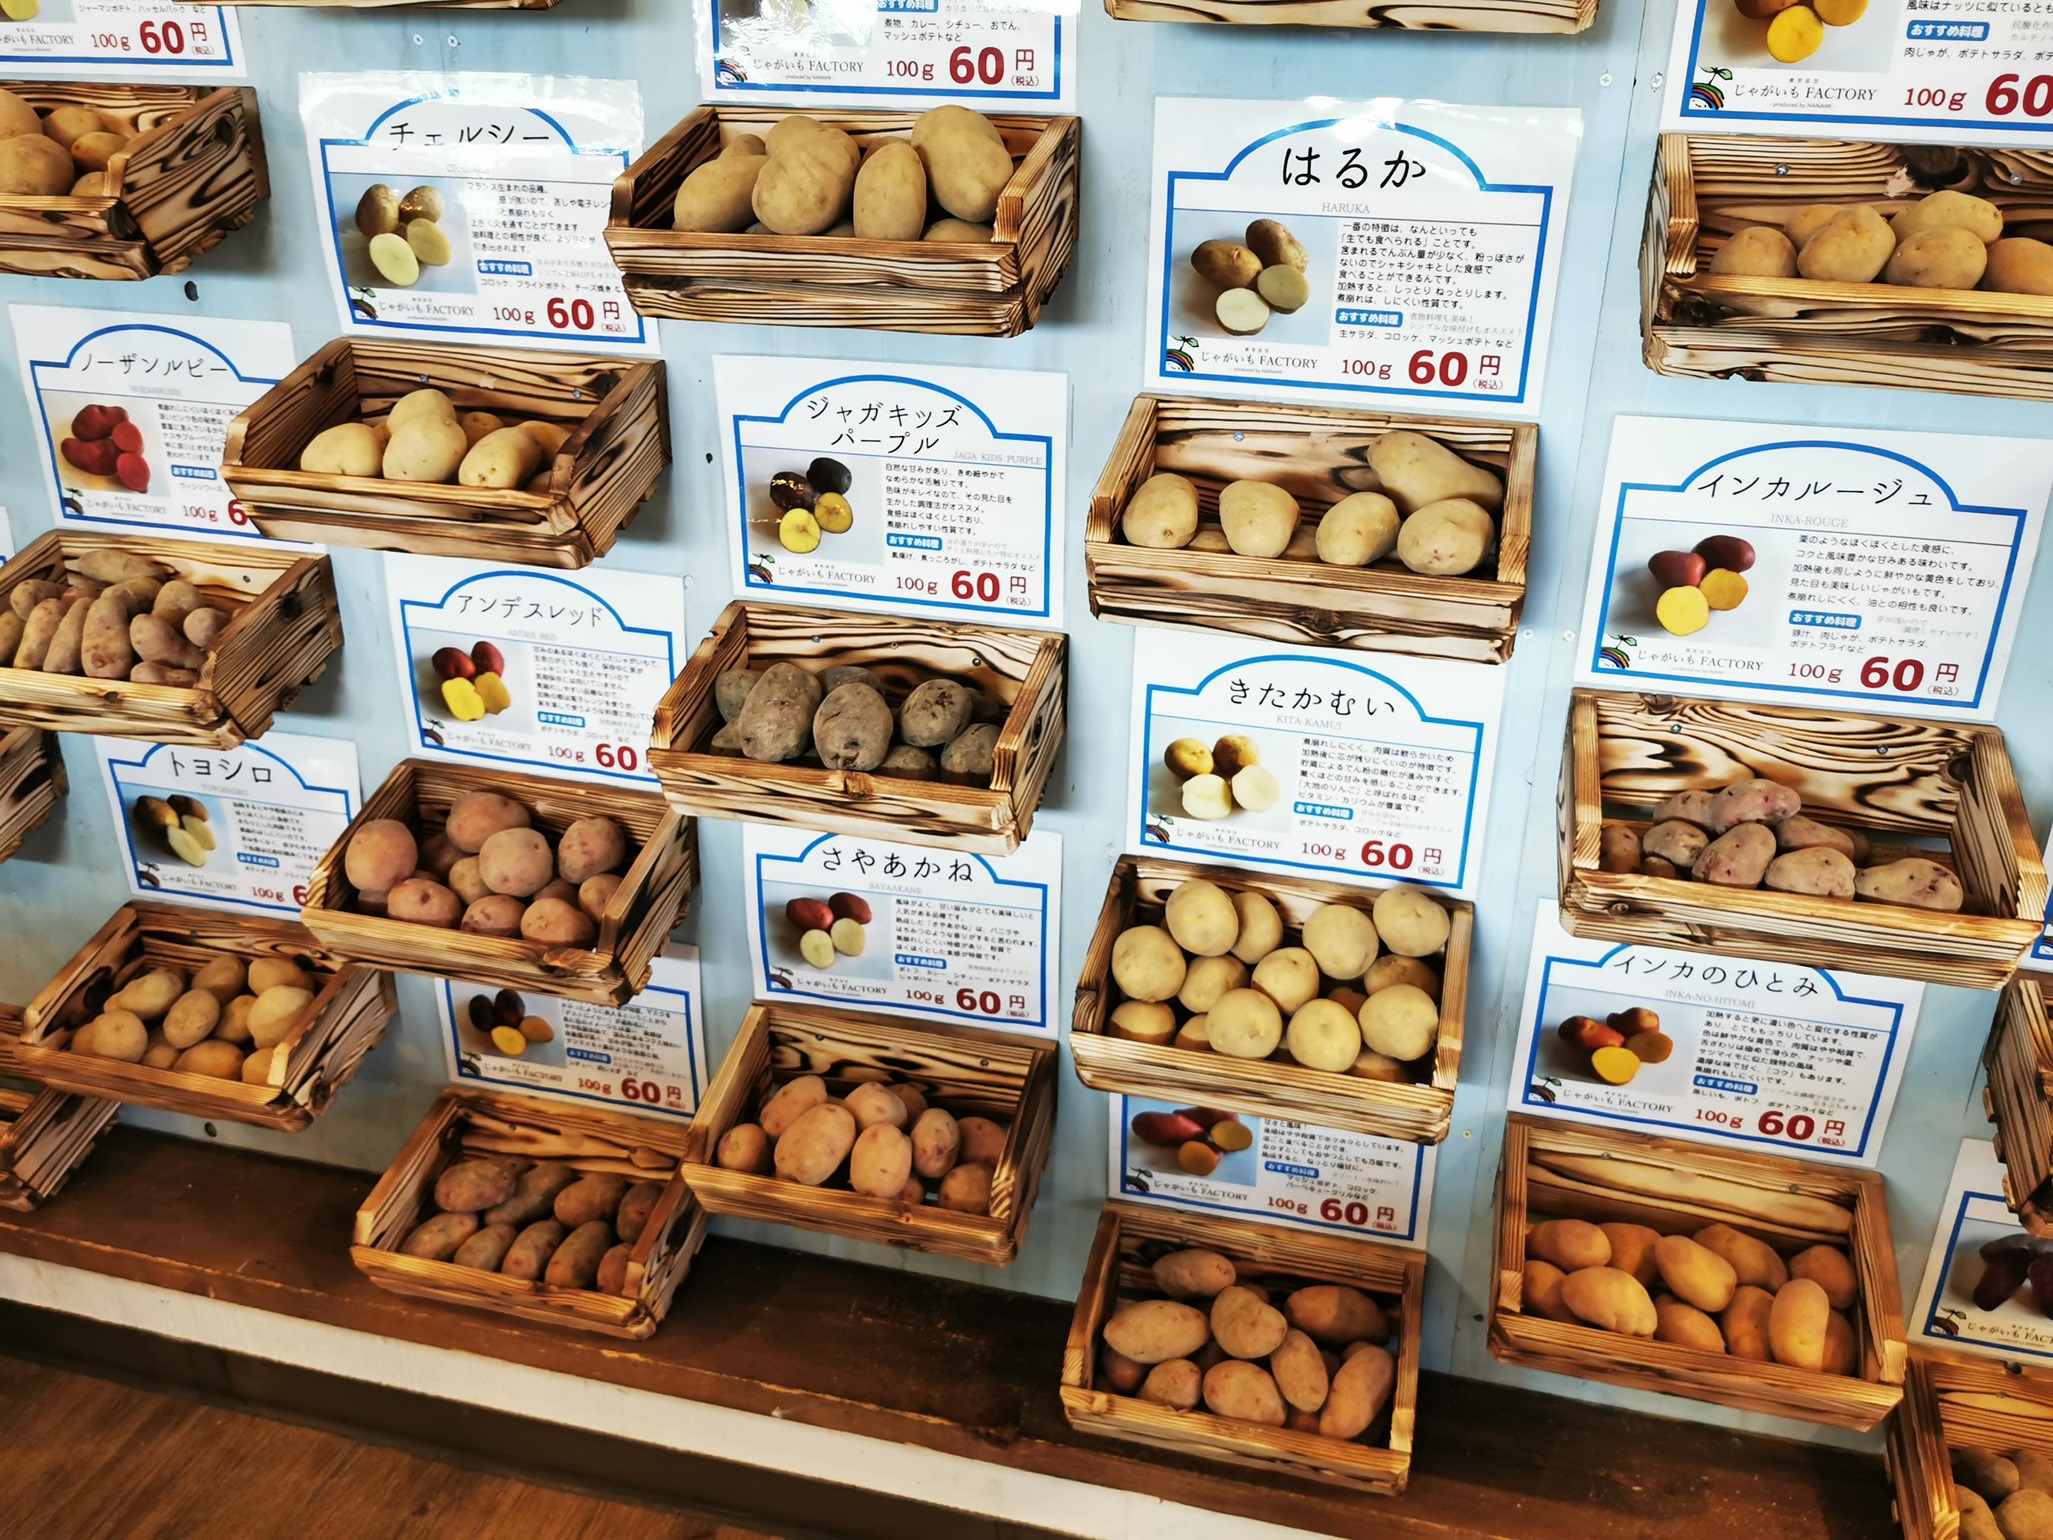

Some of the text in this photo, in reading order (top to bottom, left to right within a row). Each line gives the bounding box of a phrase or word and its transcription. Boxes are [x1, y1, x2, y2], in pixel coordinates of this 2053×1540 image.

[884, 31, 961, 42] マッシュポテトなど
[1910, 24, 1984, 38] おすすめ料理
[30, 35, 76, 45] FACTORY
[754, 59, 864, 72] じゃがいも FACTORY
[1735, 84, 1877, 100] じゃがいも FACTORY
[1986, 74, 2053, 116] 60
[389, 122, 549, 150] チェルシー
[1283, 147, 1426, 189] はるか
[1321, 202, 1370, 215] HARUKA
[480, 262, 530, 274] おすすめ料理
[379, 302, 474, 315] じゃがいも FACTORY
[1339, 311, 1399, 325] おすすめ料理
[82, 353, 228, 378] ノーザンルビー
[1201, 351, 1318, 368] じゃがいも FACTORY
[807, 396, 963, 429] ジャガキッズ
[831, 429, 940, 455] パープル
[953, 451, 1042, 465] JAGA KIDS PURPLE
[886, 475, 969, 488] なめらかな舌触りです。
[1698, 473, 1934, 508] インカルージュ
[1770, 514, 1849, 529] INKA-ROUGE
[889, 536, 939, 548] おすすめ料理
[779, 566, 823, 578] じゃがいも
[828, 571, 876, 584] FACTORY
[457, 595, 602, 627] アンデスレッド
[1792, 613, 1857, 627] おすすめ料理
[1790, 641, 1864, 654] ポテトフライなど
[1638, 651, 1694, 665] じゃがいも
[1701, 656, 1764, 670] FACTORY
[1230, 677, 1395, 716] きたかむい
[1277, 714, 1342, 730] KITA-KAMUI
[490, 736, 531, 750] FACTORY
[596, 743, 637, 770] 60
[171, 752, 272, 783] トヨシロ
[1297, 804, 1350, 818] おすすめ料理
[1229, 836, 1280, 849] FACTORY
[822, 848, 973, 883] さやあかね
[869, 882, 923, 895] SAYAAKANE
[898, 955, 944, 967] おすすめ料理
[1613, 953, 1820, 998] インカのひとみ
[842, 984, 887, 994] FACTORY
[1697, 1077, 1753, 1093] おすすめ料理
[1619, 1098, 1673, 1113] FACTORY
[1267, 1163, 1316, 1176] おすすめ料理
[1201, 1188, 1249, 1200] FACTORY
